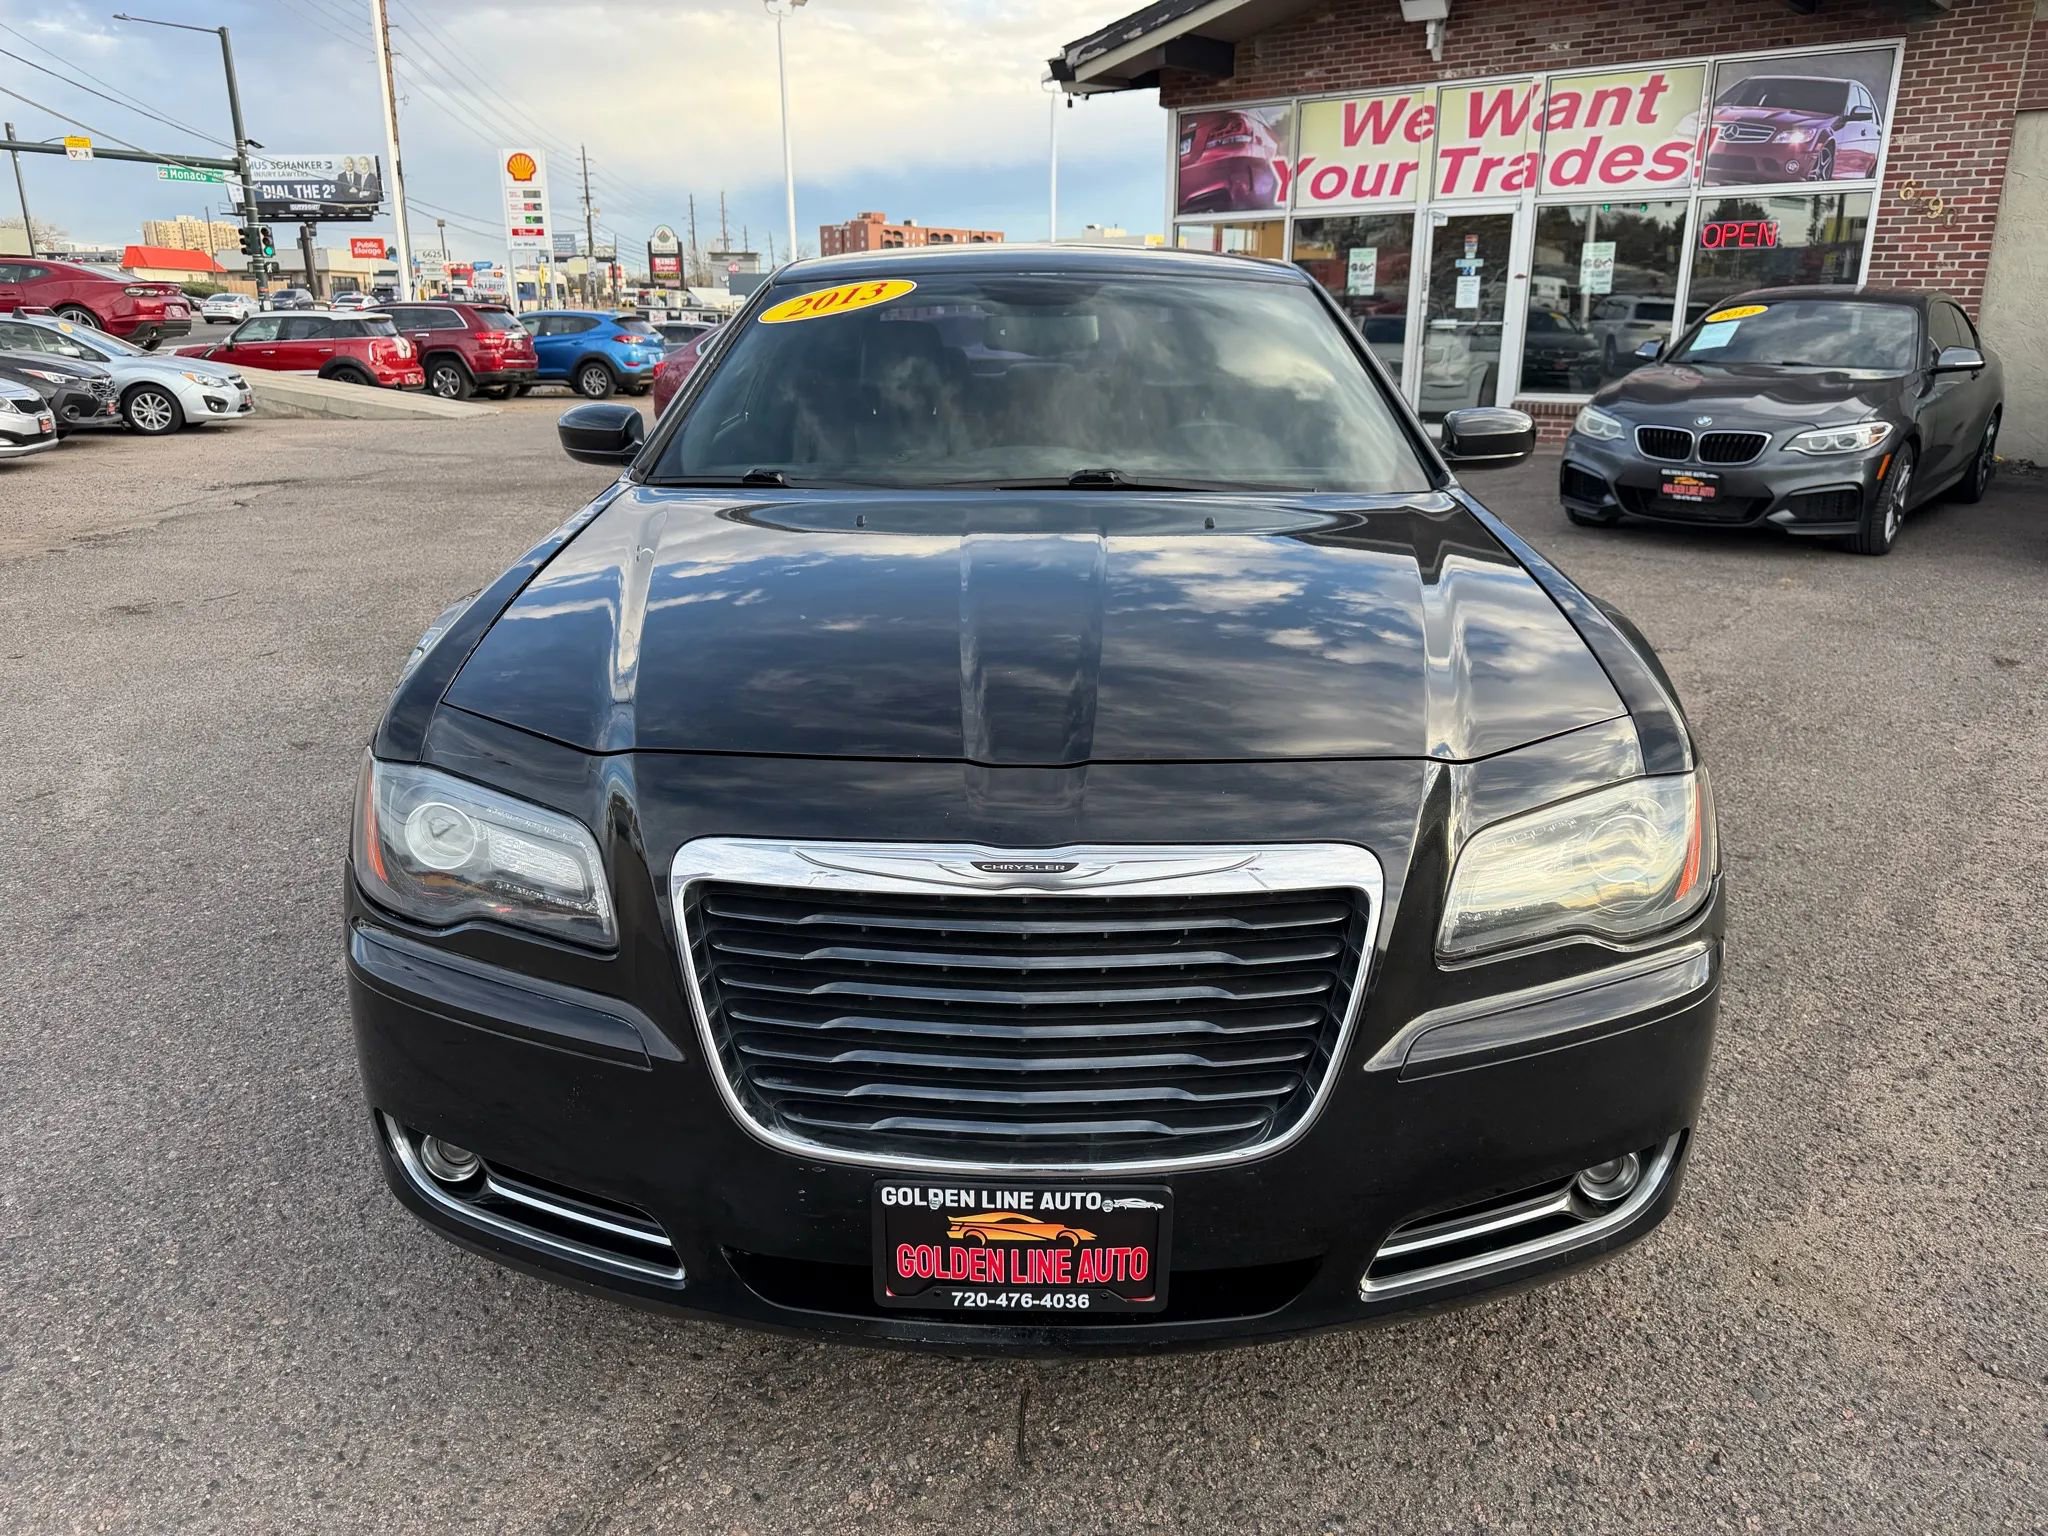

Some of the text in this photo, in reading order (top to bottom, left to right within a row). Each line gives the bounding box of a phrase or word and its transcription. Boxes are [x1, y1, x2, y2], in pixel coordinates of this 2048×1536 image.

[1343, 74, 1669, 147] We Want
[169, 169, 207, 180] Monaco
[270, 160, 322, 170] SCHANKER
[1272, 127, 1719, 203] Your Trades!
[263, 184, 292, 199] DIAL
[294, 184, 321, 199] THE
[1702, 222, 1777, 248] OPEN
[784, 282, 888, 318] 2013
[881, 1186, 1102, 1210] GOLDEN LINE AUTO
[896, 1243, 1148, 1284] GOLDEN LINE AUTO
[951, 1291, 1090, 1308] 720-476-4036
